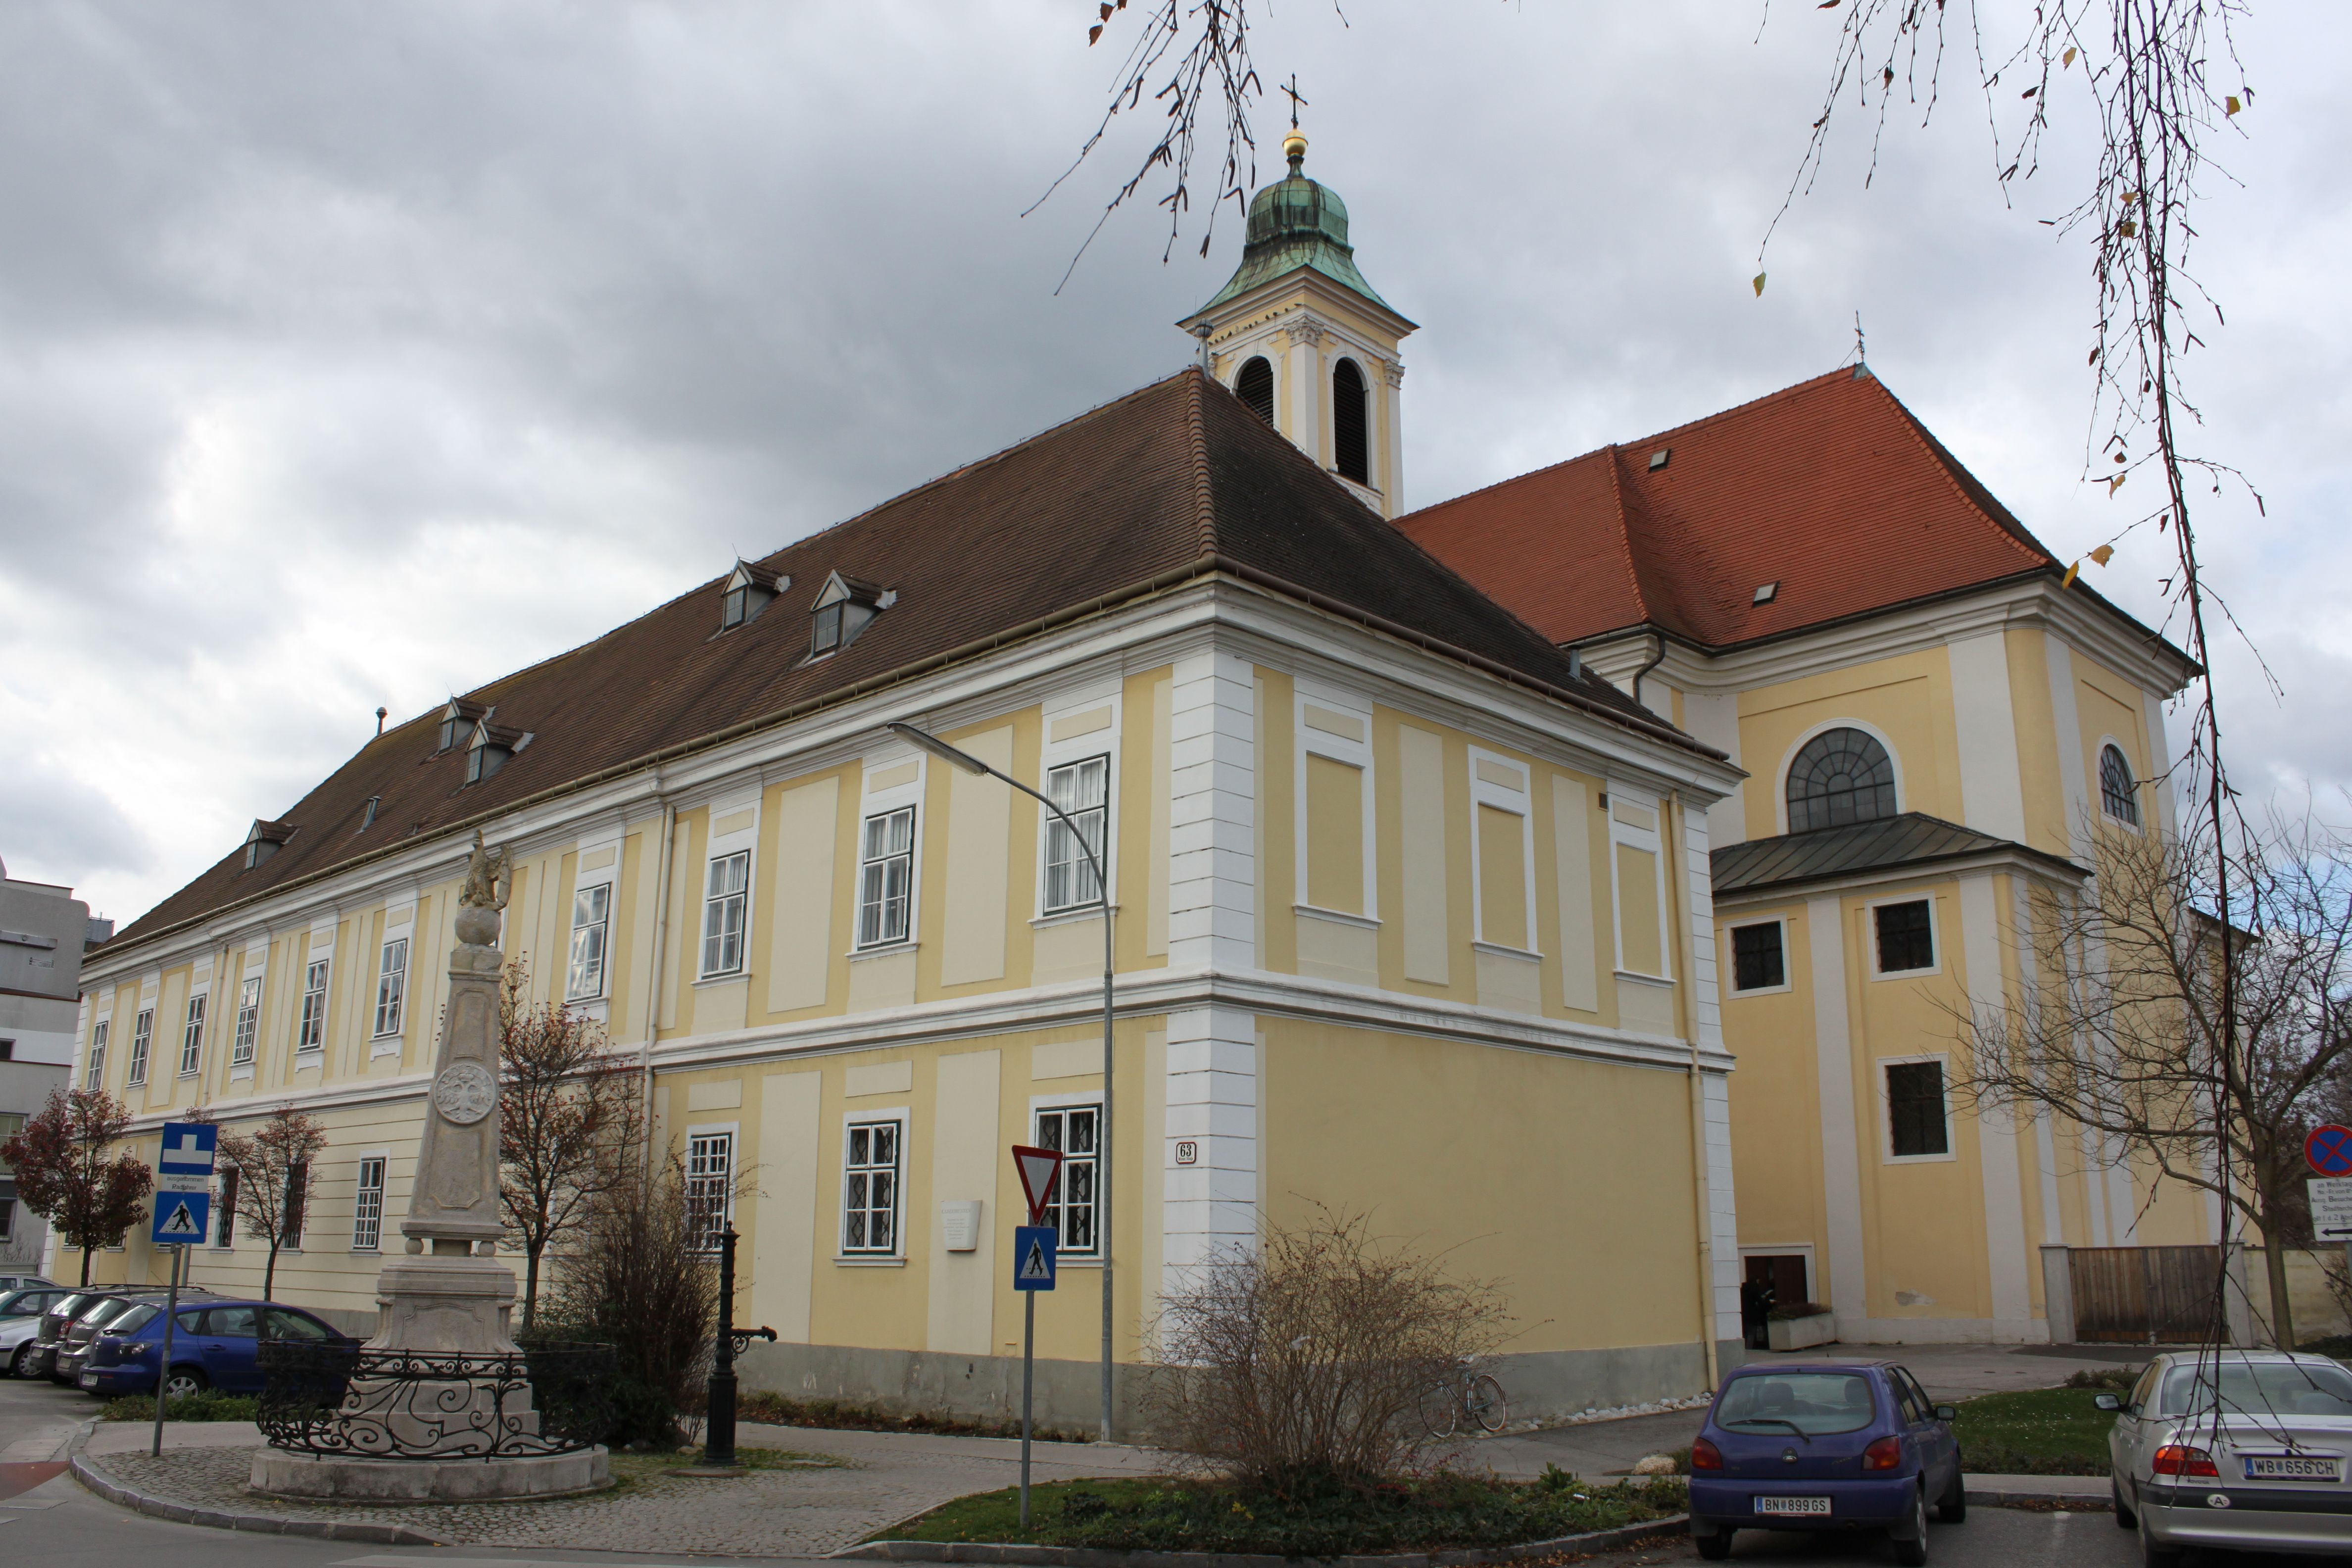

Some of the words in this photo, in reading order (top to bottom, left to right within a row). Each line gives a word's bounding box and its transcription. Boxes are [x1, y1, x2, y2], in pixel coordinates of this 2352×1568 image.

[1180, 1144, 1191, 1157] 63
[2254, 1460, 2275, 1473] WB
[2285, 1461, 2313, 1474] 656
[2316, 1461, 2334, 1475] CH
[1765, 1499, 1779, 1511] BN
[1788, 1499, 1810, 1511] 899
[1812, 1500, 1826, 1512] GS
[2214, 1496, 2225, 1506] A
